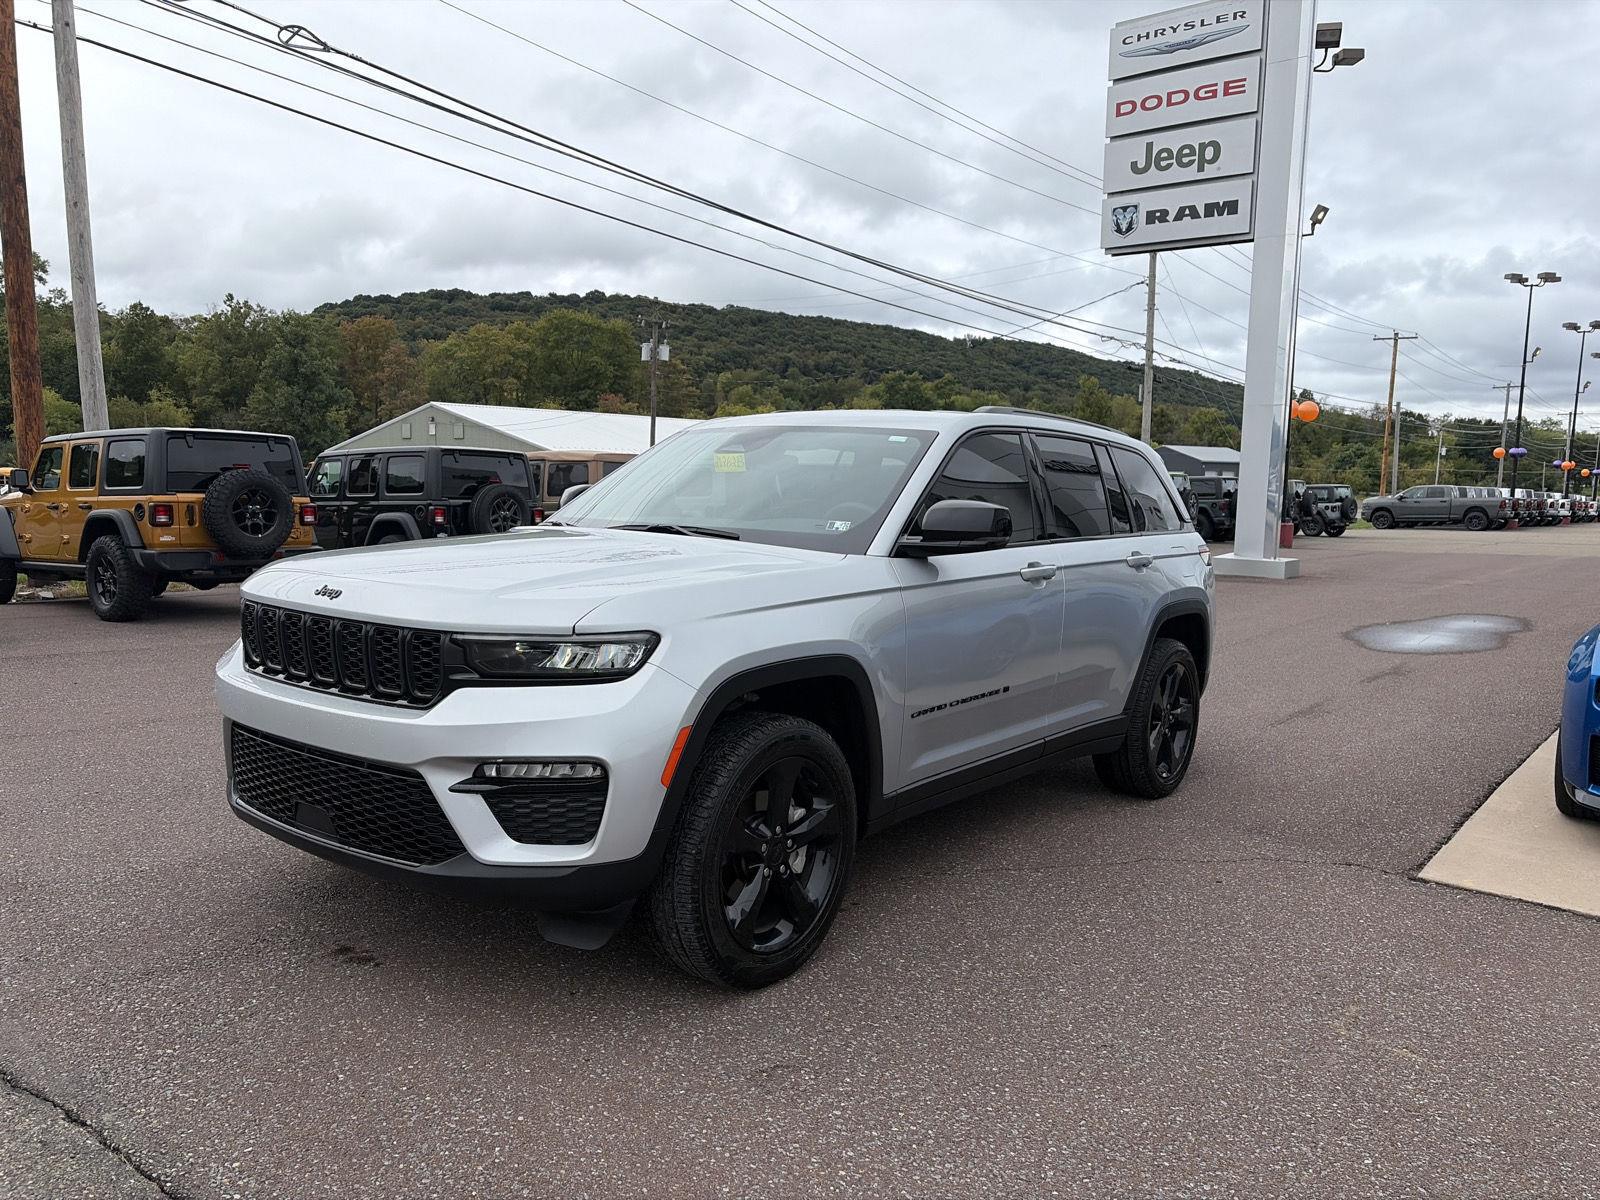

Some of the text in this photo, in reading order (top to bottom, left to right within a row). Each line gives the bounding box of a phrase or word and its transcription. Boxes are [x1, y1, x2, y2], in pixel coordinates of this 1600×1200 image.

[1121, 10, 1247, 46] CHRYSLER
[1115, 77, 1248, 117] DODGE
[1130, 139, 1222, 175] Jeep
[1145, 199, 1239, 225] RAM
[314, 584, 342, 600] Jeep
[911, 703, 947, 719] GRAND
